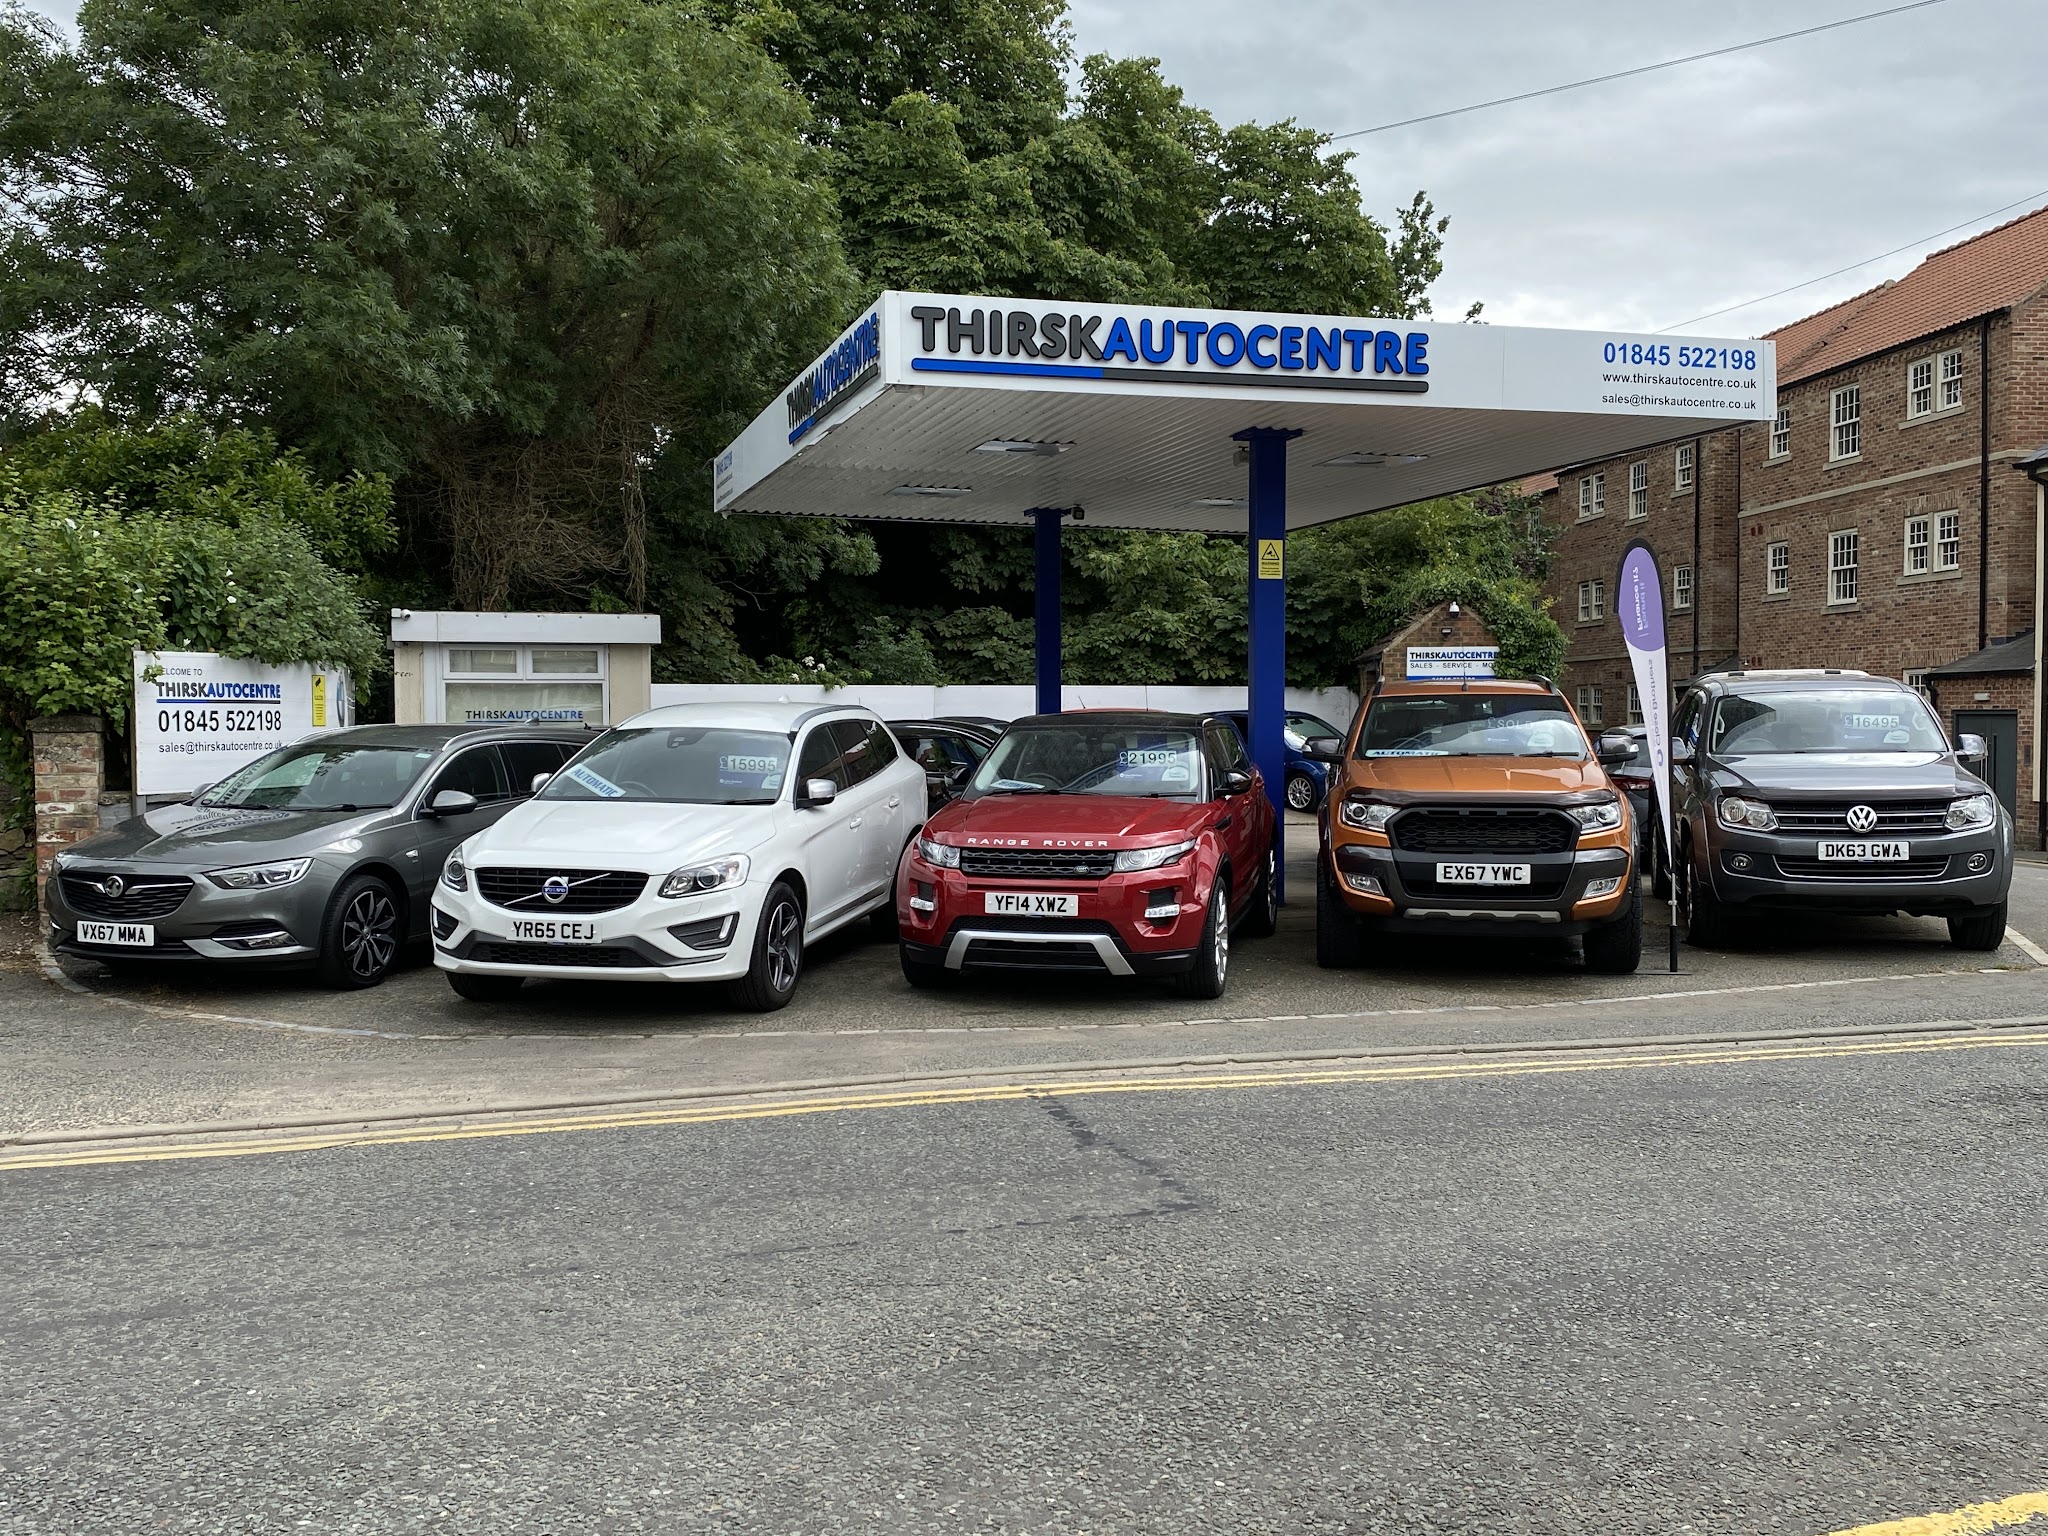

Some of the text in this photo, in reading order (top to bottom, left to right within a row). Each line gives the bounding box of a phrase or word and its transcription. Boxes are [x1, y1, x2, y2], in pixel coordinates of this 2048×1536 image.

[911, 306, 1429, 375] THIRSKAUTOCENTRE
[1603, 342, 1756, 371] 01845 522198
[1602, 373, 1757, 389] www.thirskautocentre.co.uk
[1601, 393, 1757, 410] sales@thirskautocentre.co.uk
[1409, 651, 1499, 660] THIRSKAUTOCENTRE
[193, 668, 203, 676] TO
[156, 681, 281, 699] THIRSKAUTOCENTRE
[158, 709, 282, 732] 01845 522198
[465, 710, 584, 719] THIRSKAUTOCENTRE
[1844, 714, 1899, 729] £16495
[158, 740, 283, 755] sales@thirskautocentre.co.uk
[719, 755, 776, 772] £15995
[1119, 751, 1176, 765] £21995
[570, 768, 619, 797] AUTOMATIC
[967, 837, 1109, 847] RANGE ROVER
[1825, 843, 1902, 858] DK63 GWA
[1443, 865, 1523, 881] EX67 YWC
[995, 895, 1068, 913] YF14 XWZ
[81, 923, 146, 943] VX67 MMA
[513, 921, 594, 940] YR65 CEJ
